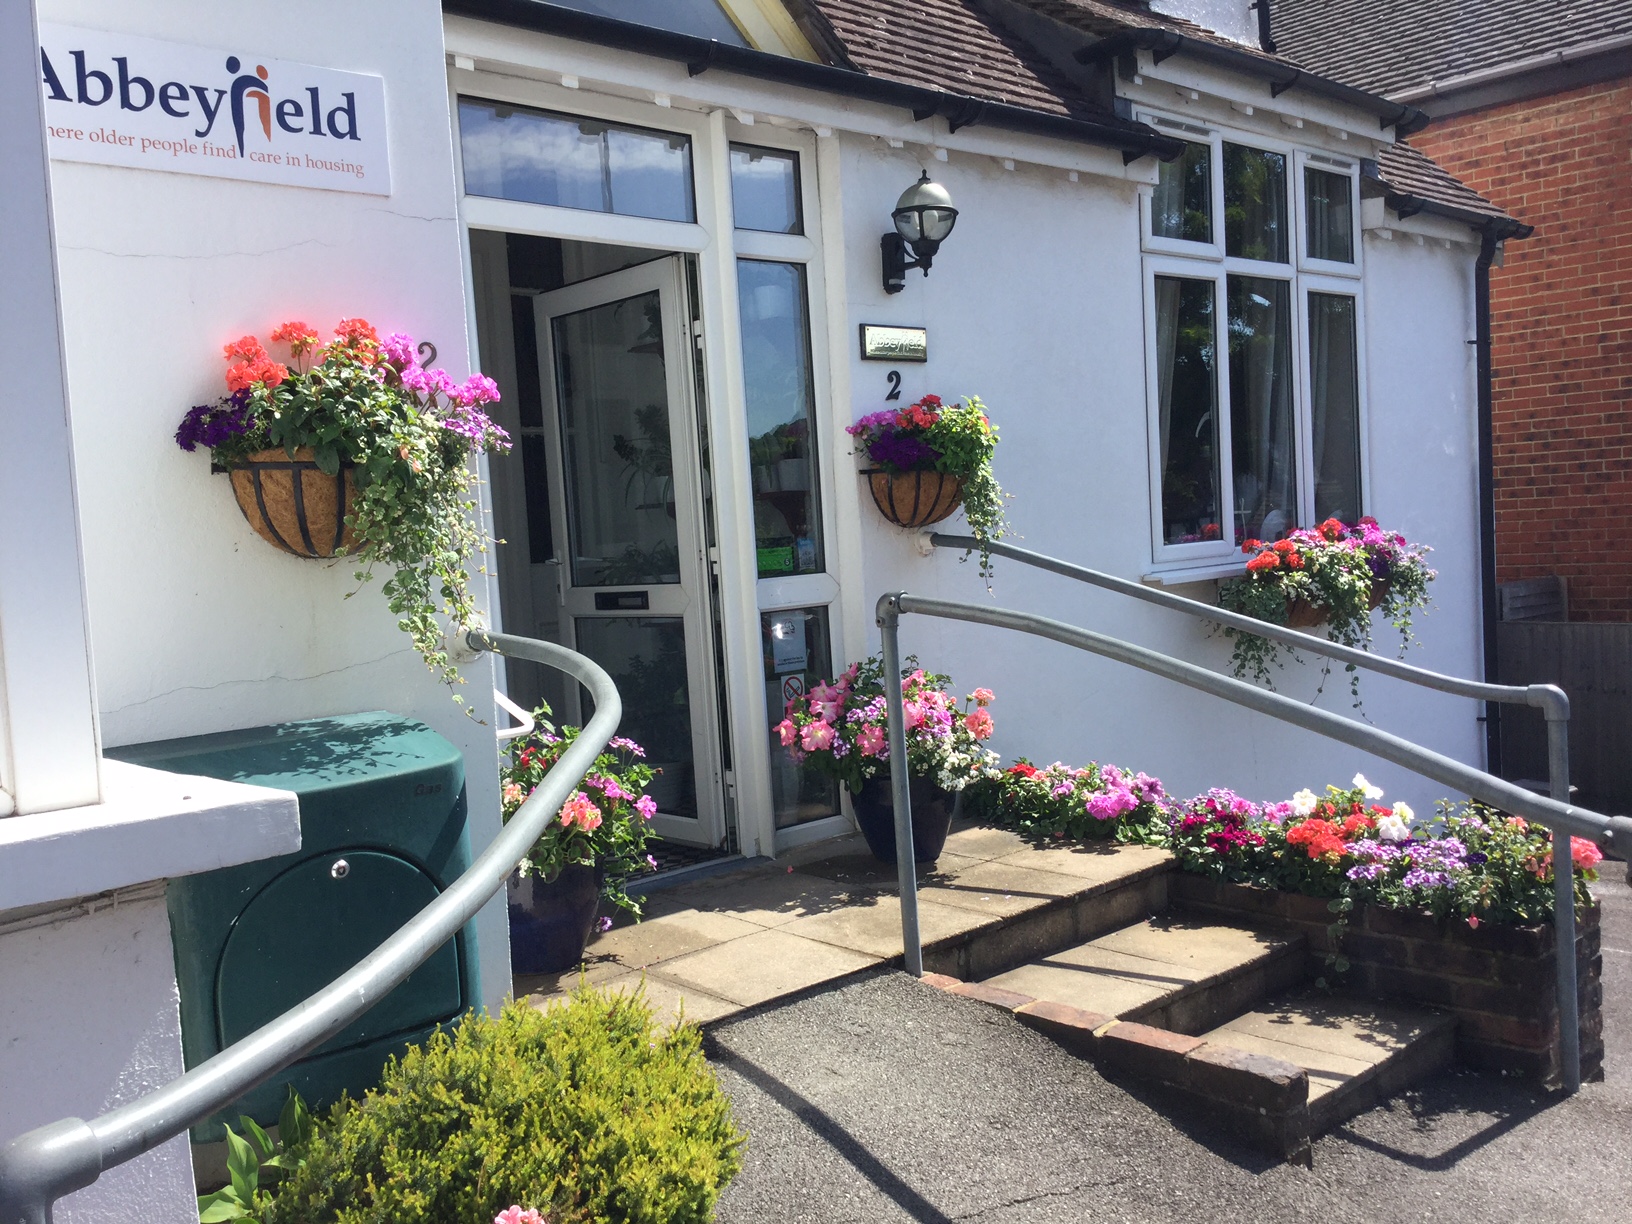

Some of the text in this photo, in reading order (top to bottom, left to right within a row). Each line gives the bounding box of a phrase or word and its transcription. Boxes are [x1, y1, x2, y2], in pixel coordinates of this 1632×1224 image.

[89, 127, 135, 147] older
[141, 137, 198, 157] people
[203, 141, 237, 159] find
[249, 151, 282, 165] care
[286, 152, 302, 167] in
[305, 154, 364, 179] housing
[885, 370, 901, 401] 2
[415, 783, 442, 795] Gas
